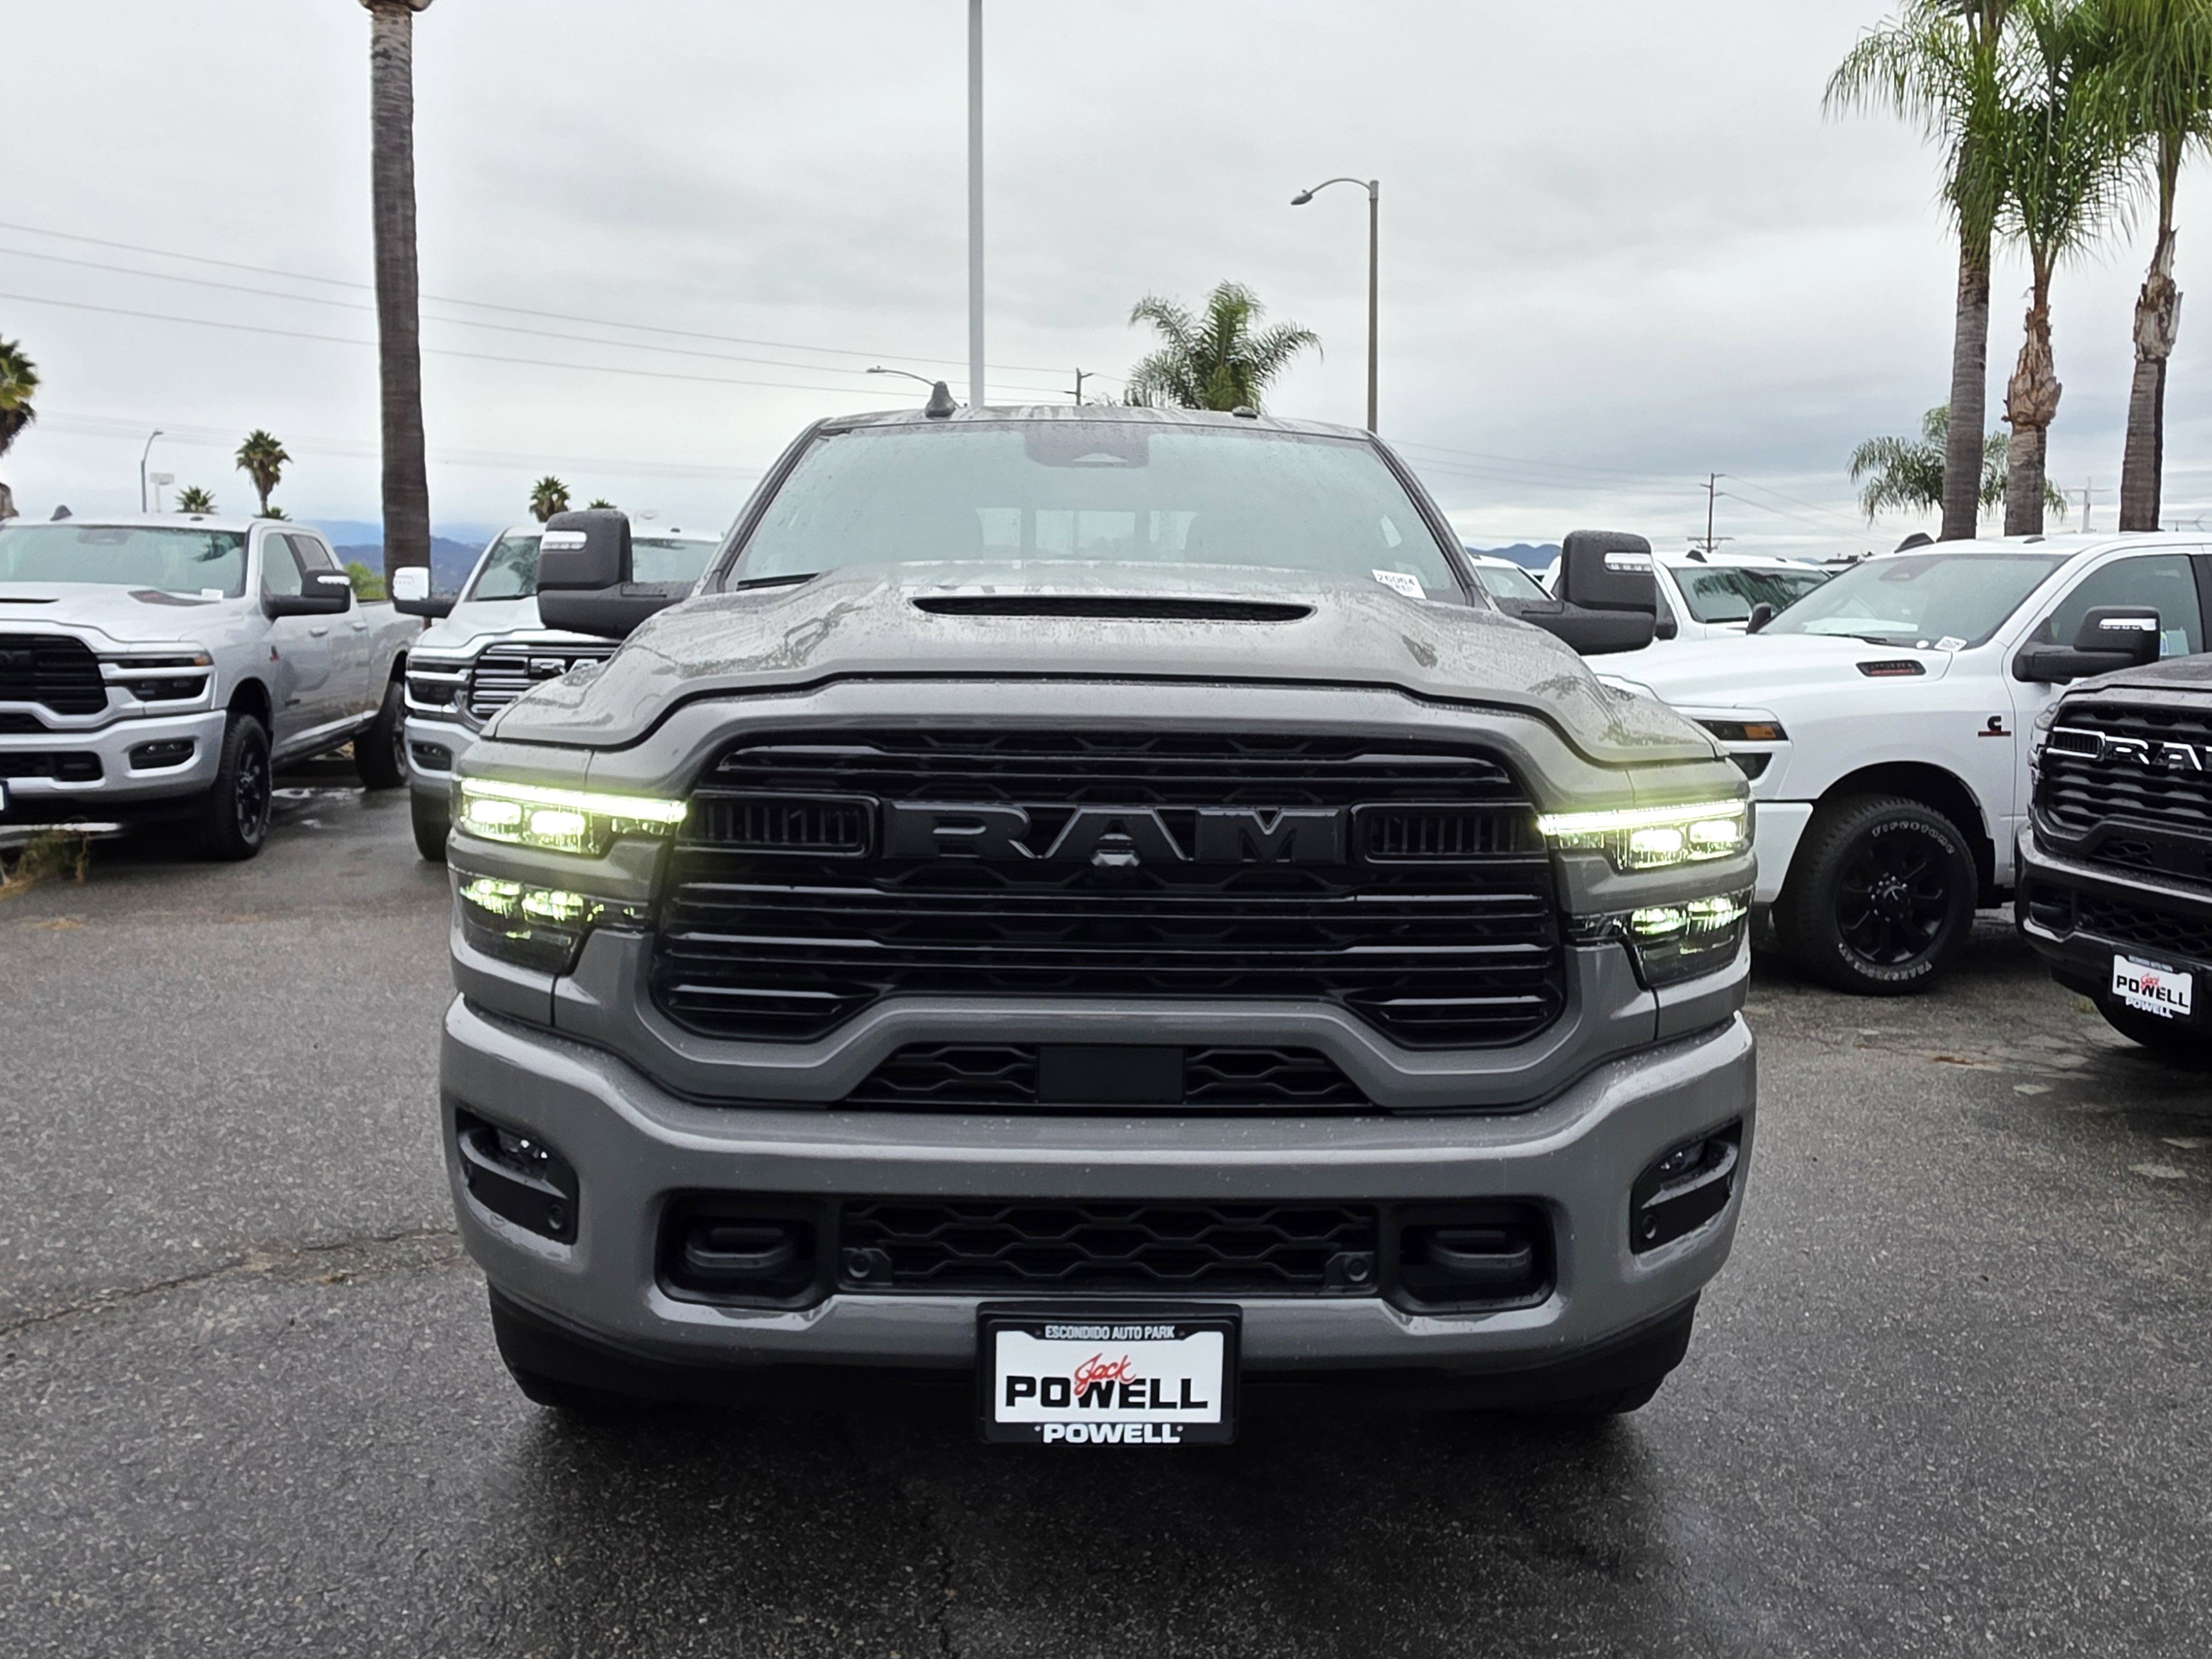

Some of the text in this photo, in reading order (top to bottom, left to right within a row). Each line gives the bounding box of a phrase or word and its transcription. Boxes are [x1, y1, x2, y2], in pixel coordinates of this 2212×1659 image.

[881, 800, 1346, 863] RAM
[2117, 975, 2189, 1008] POWELL
[1045, 1325, 1175, 1340] ESCONDIDO AUTO PARK
[1074, 1353, 1136, 1396] Jack
[1006, 1376, 1208, 1409] POWELL
[1043, 1424, 1181, 1443] POWELL
